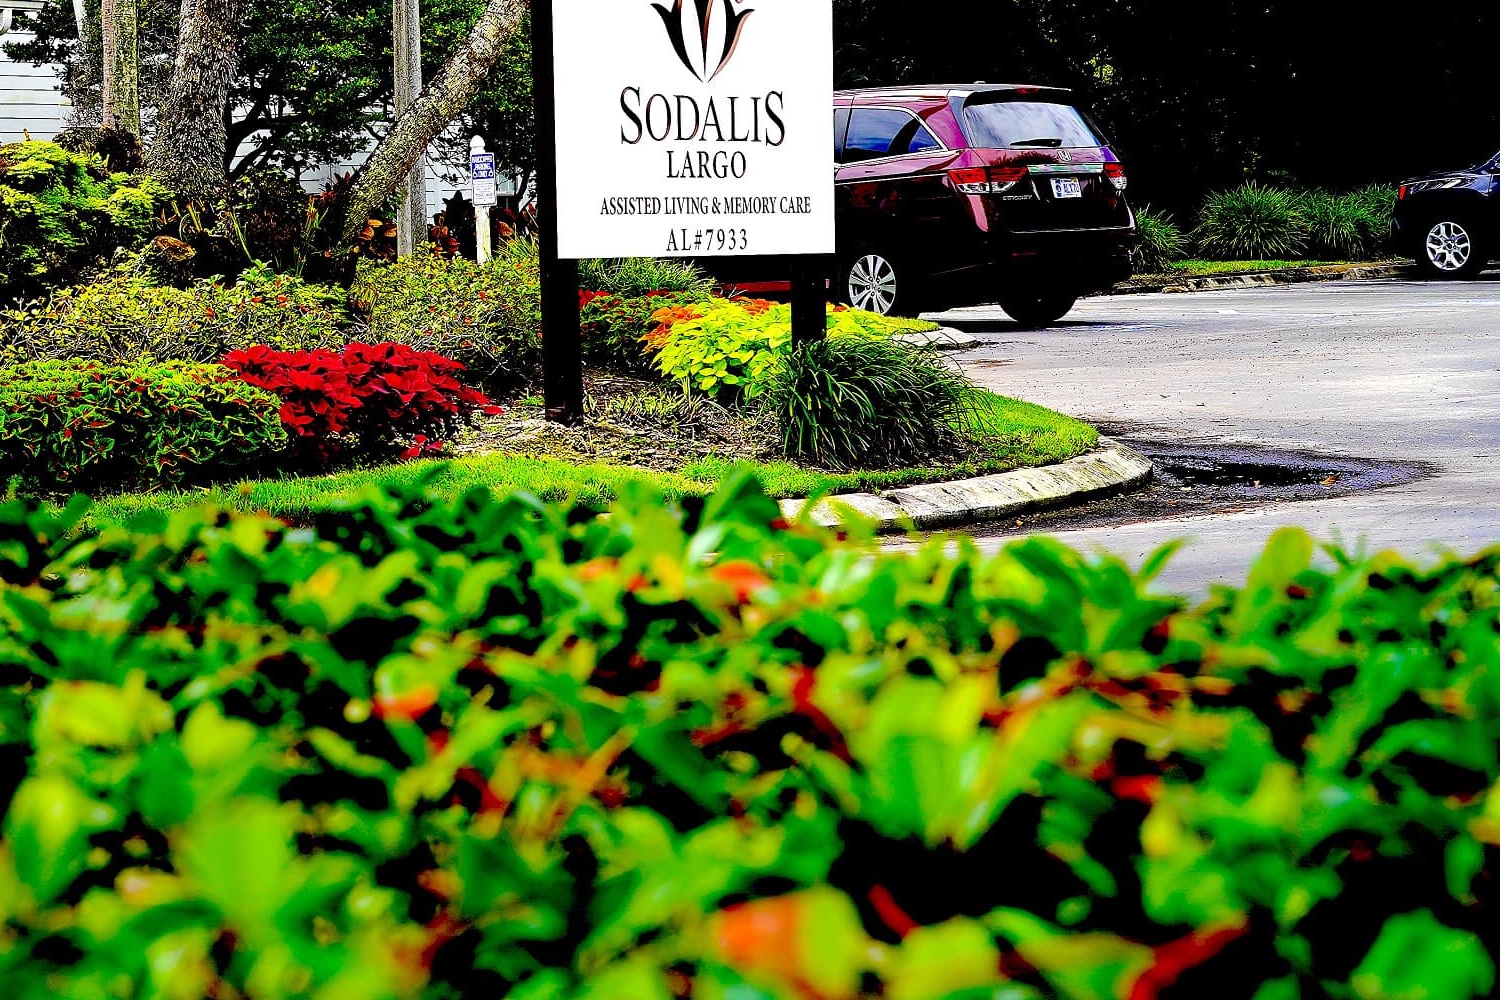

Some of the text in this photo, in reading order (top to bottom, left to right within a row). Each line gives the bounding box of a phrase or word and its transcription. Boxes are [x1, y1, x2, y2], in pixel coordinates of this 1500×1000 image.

[620, 86, 786, 147] SODALIS
[666, 150, 747, 179] LARGO
[599, 196, 812, 216] ASSISTED LIVING & MEMORY CARE
[666, 228, 748, 252] AL#7933
